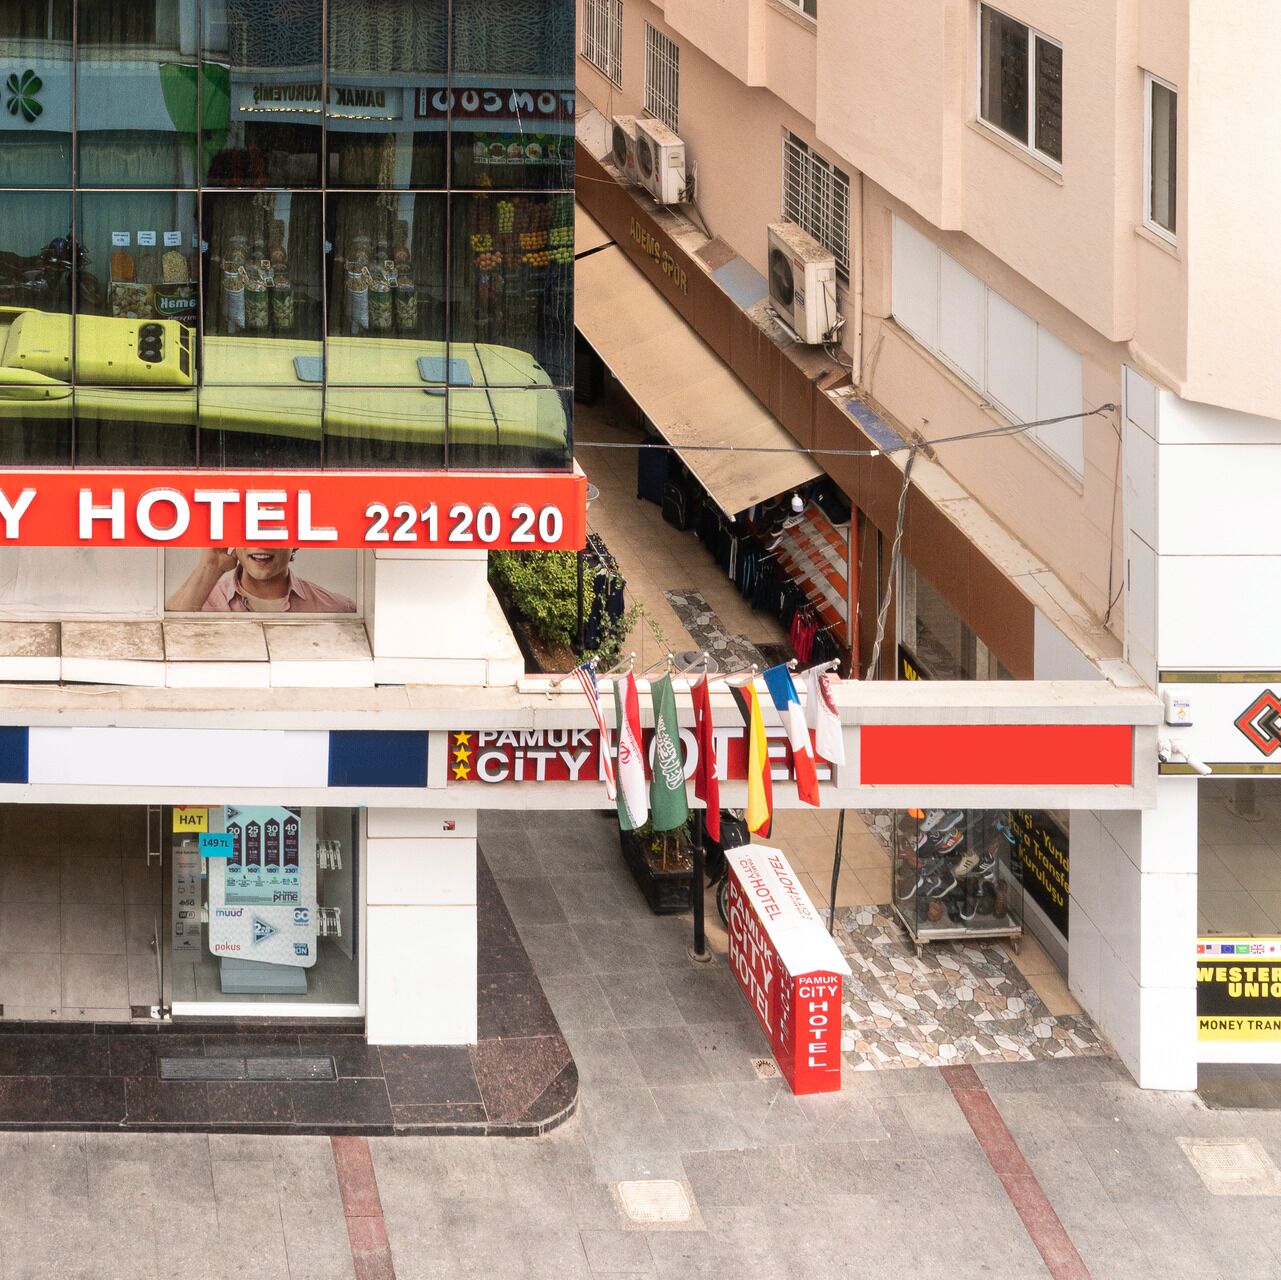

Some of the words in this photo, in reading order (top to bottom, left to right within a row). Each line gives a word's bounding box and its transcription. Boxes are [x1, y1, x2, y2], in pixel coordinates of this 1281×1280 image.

[78, 487, 339, 542] HOTEL
[364, 502, 438, 542] 221
[510, 504, 564, 544] 20
[478, 729, 592, 747] PAMUK
[179, 815, 203, 825] HAT
[284, 823, 297, 832] 40
[247, 825, 259, 834] 25
[266, 825, 278, 833] 30
[202, 838, 219, 847] 149
[221, 840, 229, 848] TL
[1042, 829, 1070, 873] Yurtd
[1033, 839, 1070, 894] Transfe
[750, 878, 783, 921] HOTEL
[730, 881, 773, 970] PAMUK
[215, 941, 241, 952] pokus
[799, 976, 838, 985] PAMUK
[1196, 967, 1281, 982] WESTER
[730, 934, 773, 1035] HOTEL
[1228, 982, 1281, 998] UNIO
[1200, 1020, 1243, 1030] MONEY
[1247, 1020, 1281, 1030] TRAN
[808, 1000, 828, 1068] HOTEL
